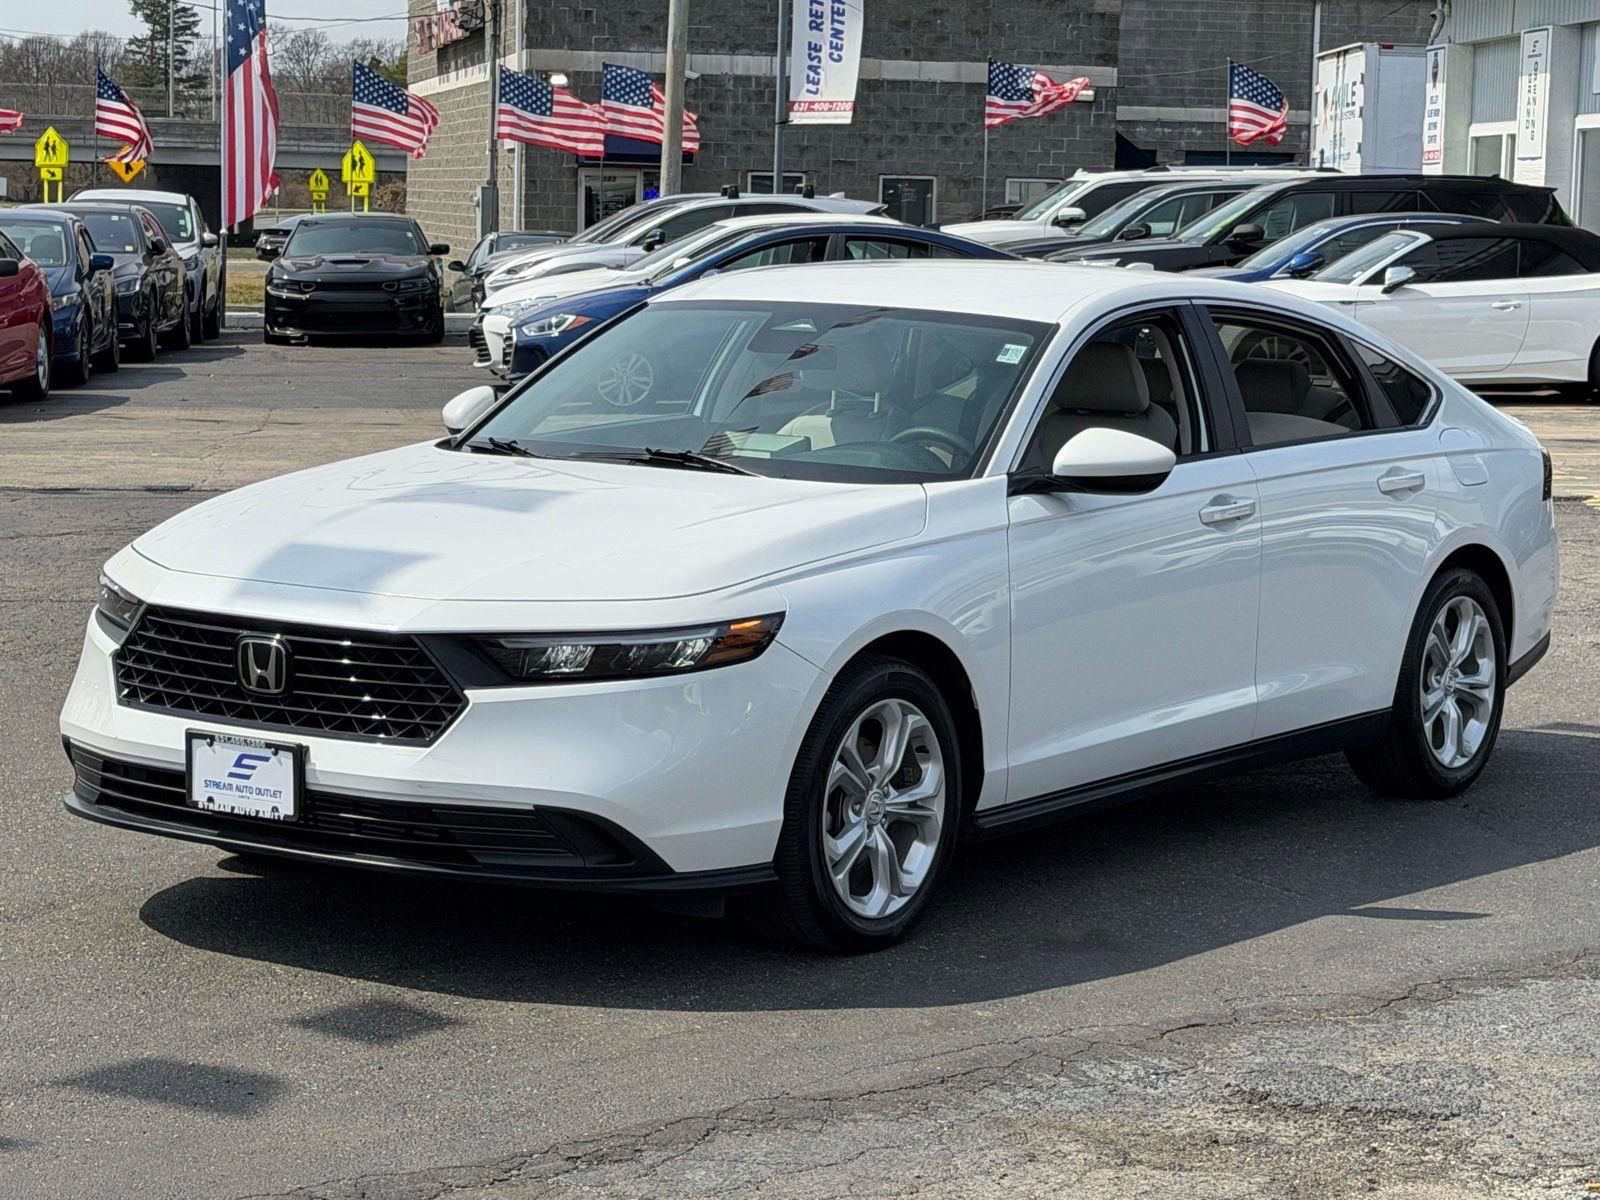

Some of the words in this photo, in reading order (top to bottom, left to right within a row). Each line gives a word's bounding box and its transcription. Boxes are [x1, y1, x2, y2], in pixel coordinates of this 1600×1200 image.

[806, 41, 823, 95] LEASE
[203, 779, 234, 792] STREAM
[235, 783, 254, 795] AUTO
[254, 787, 283, 799] OUTLET
